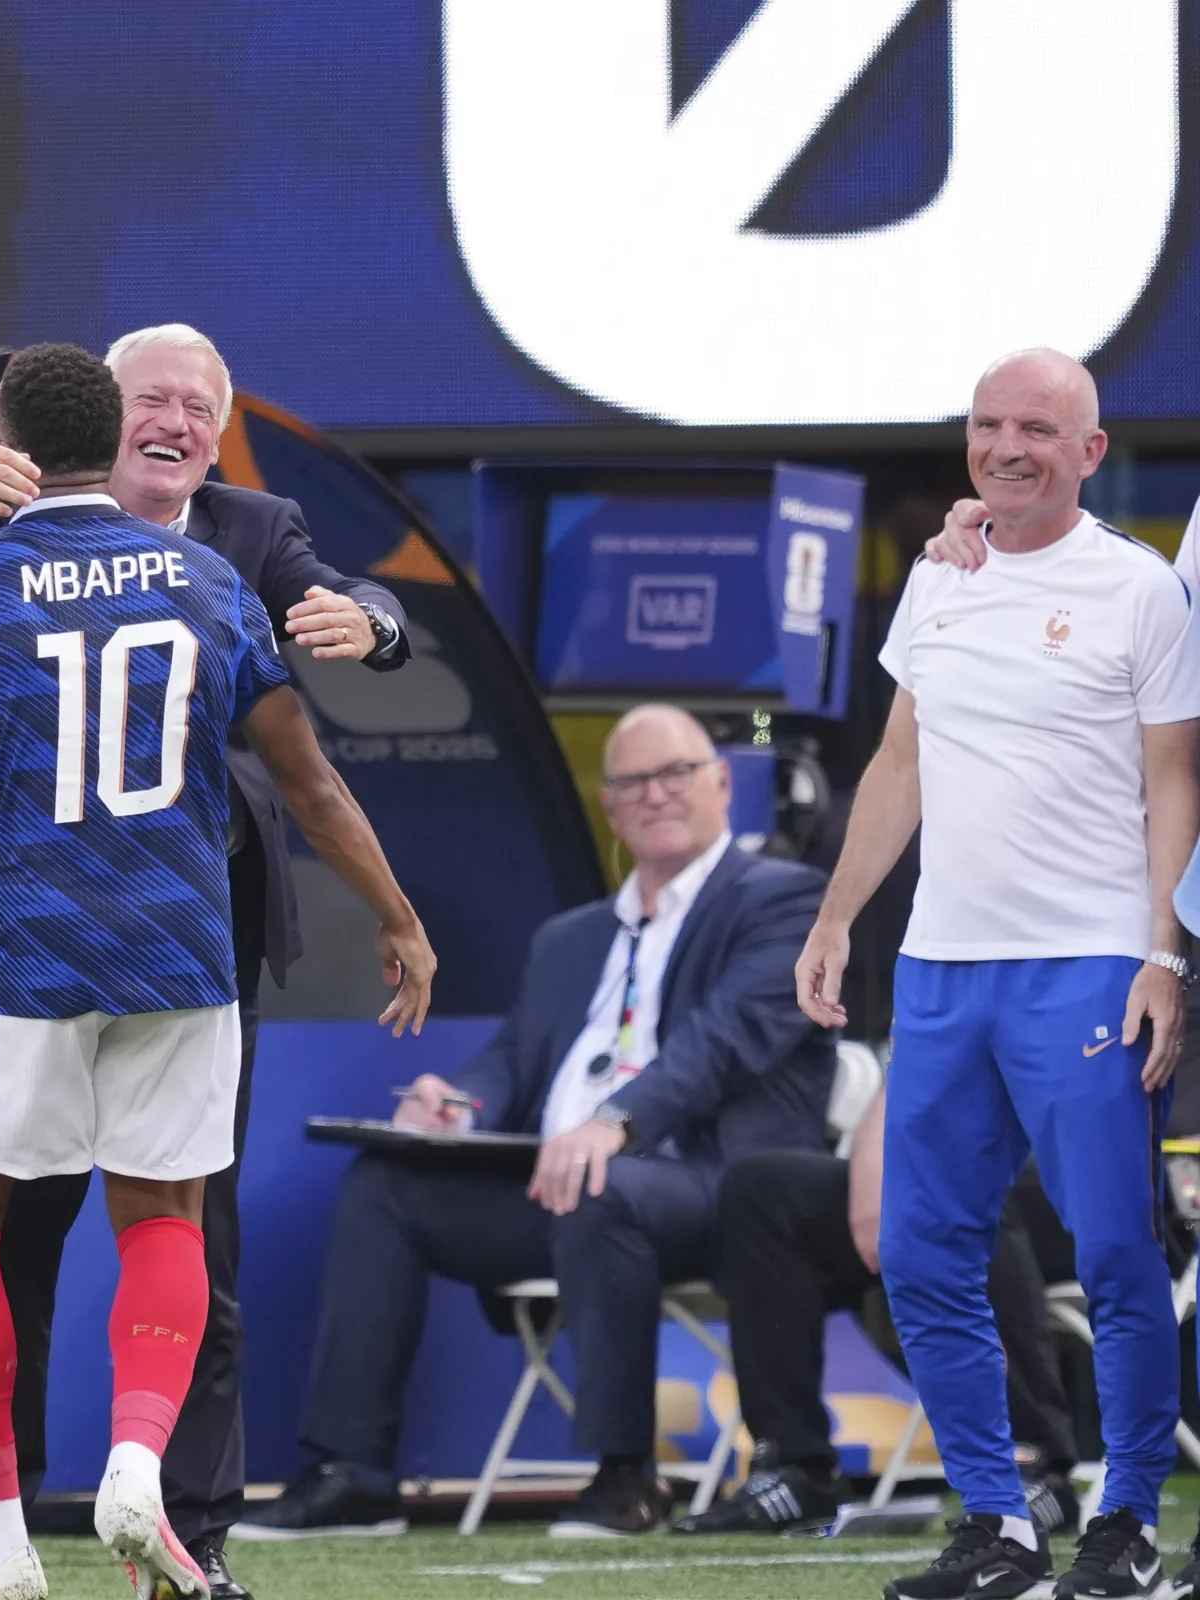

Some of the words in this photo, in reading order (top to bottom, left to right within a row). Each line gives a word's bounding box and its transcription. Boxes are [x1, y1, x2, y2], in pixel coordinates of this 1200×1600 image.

[21, 551, 189, 603] MBAPPE
[641, 591, 704, 627] VAR
[37, 620, 198, 823] 10
[132, 1324, 187, 1344] FFF
